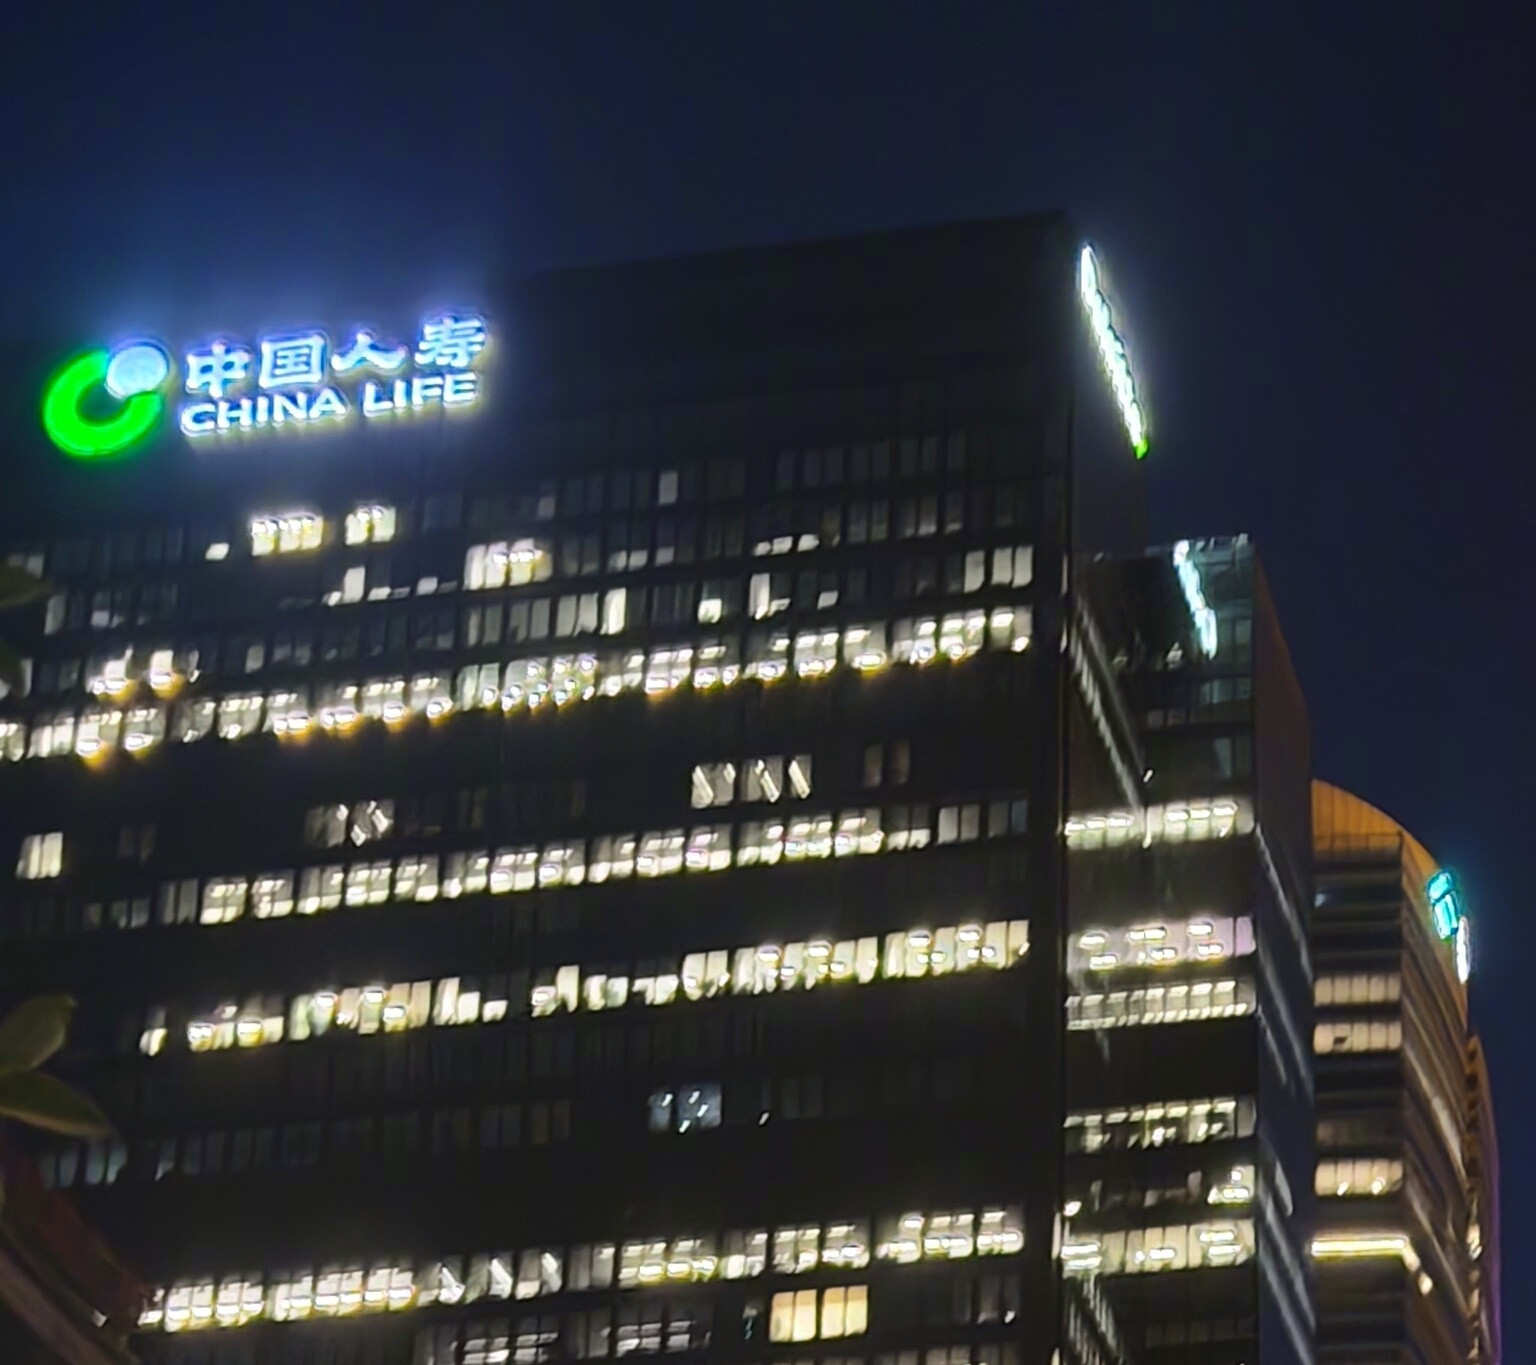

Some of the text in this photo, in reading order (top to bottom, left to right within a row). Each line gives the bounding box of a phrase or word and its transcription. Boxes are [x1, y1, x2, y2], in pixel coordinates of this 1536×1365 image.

[186, 314, 486, 397] 中国人寿
[182, 371, 479, 435] CHINA LIFE
